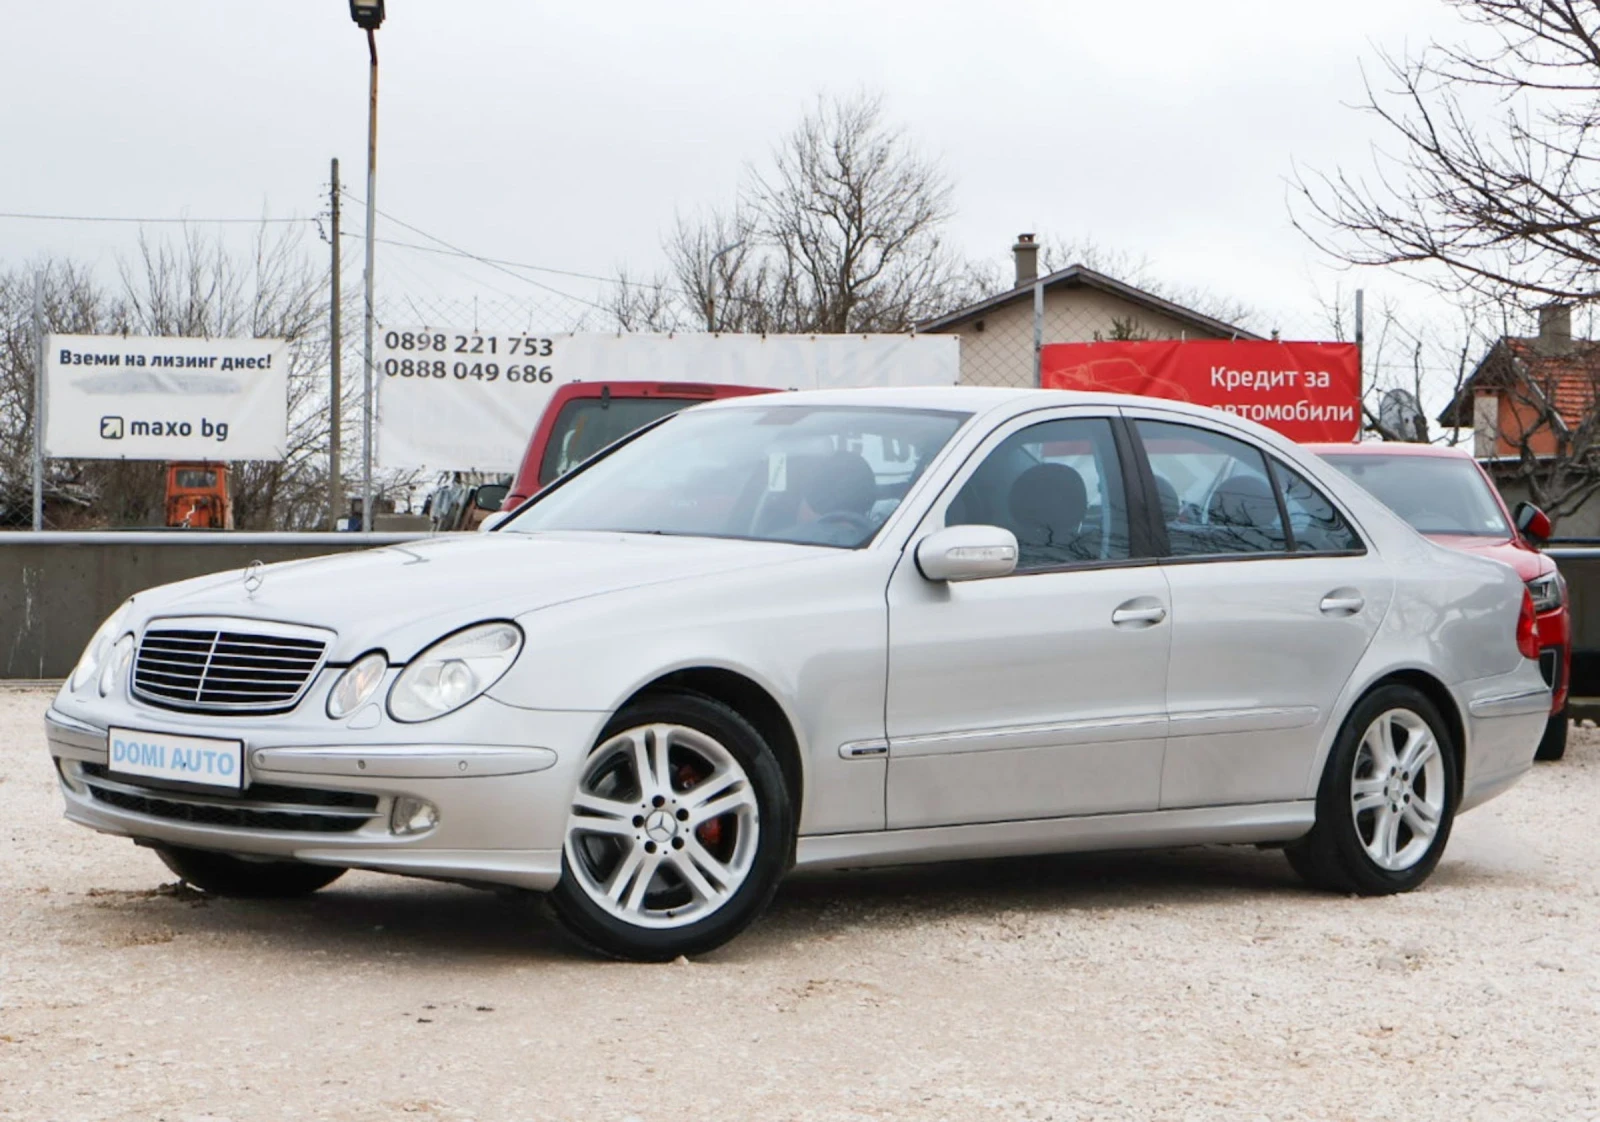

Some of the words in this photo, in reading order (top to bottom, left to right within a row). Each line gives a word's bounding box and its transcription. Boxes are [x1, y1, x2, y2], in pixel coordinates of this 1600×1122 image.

[385, 331, 447, 352] 0898
[454, 335, 498, 354] 221
[507, 337, 554, 357] 753
[59, 350, 120, 366] Вземи
[125, 354, 147, 367] на
[150, 355, 218, 369] лизинг
[220, 354, 272, 371] днес!
[385, 358, 447, 379] 0888
[453, 361, 500, 382] 049
[506, 364, 554, 384] 686
[1211, 366, 1299, 392] Кредит
[1304, 370, 1330, 388] за
[130, 420, 193, 437] maxo
[201, 417, 229, 442] bg
[113, 739, 166, 769] DOMI
[171, 747, 235, 776] AUTO
